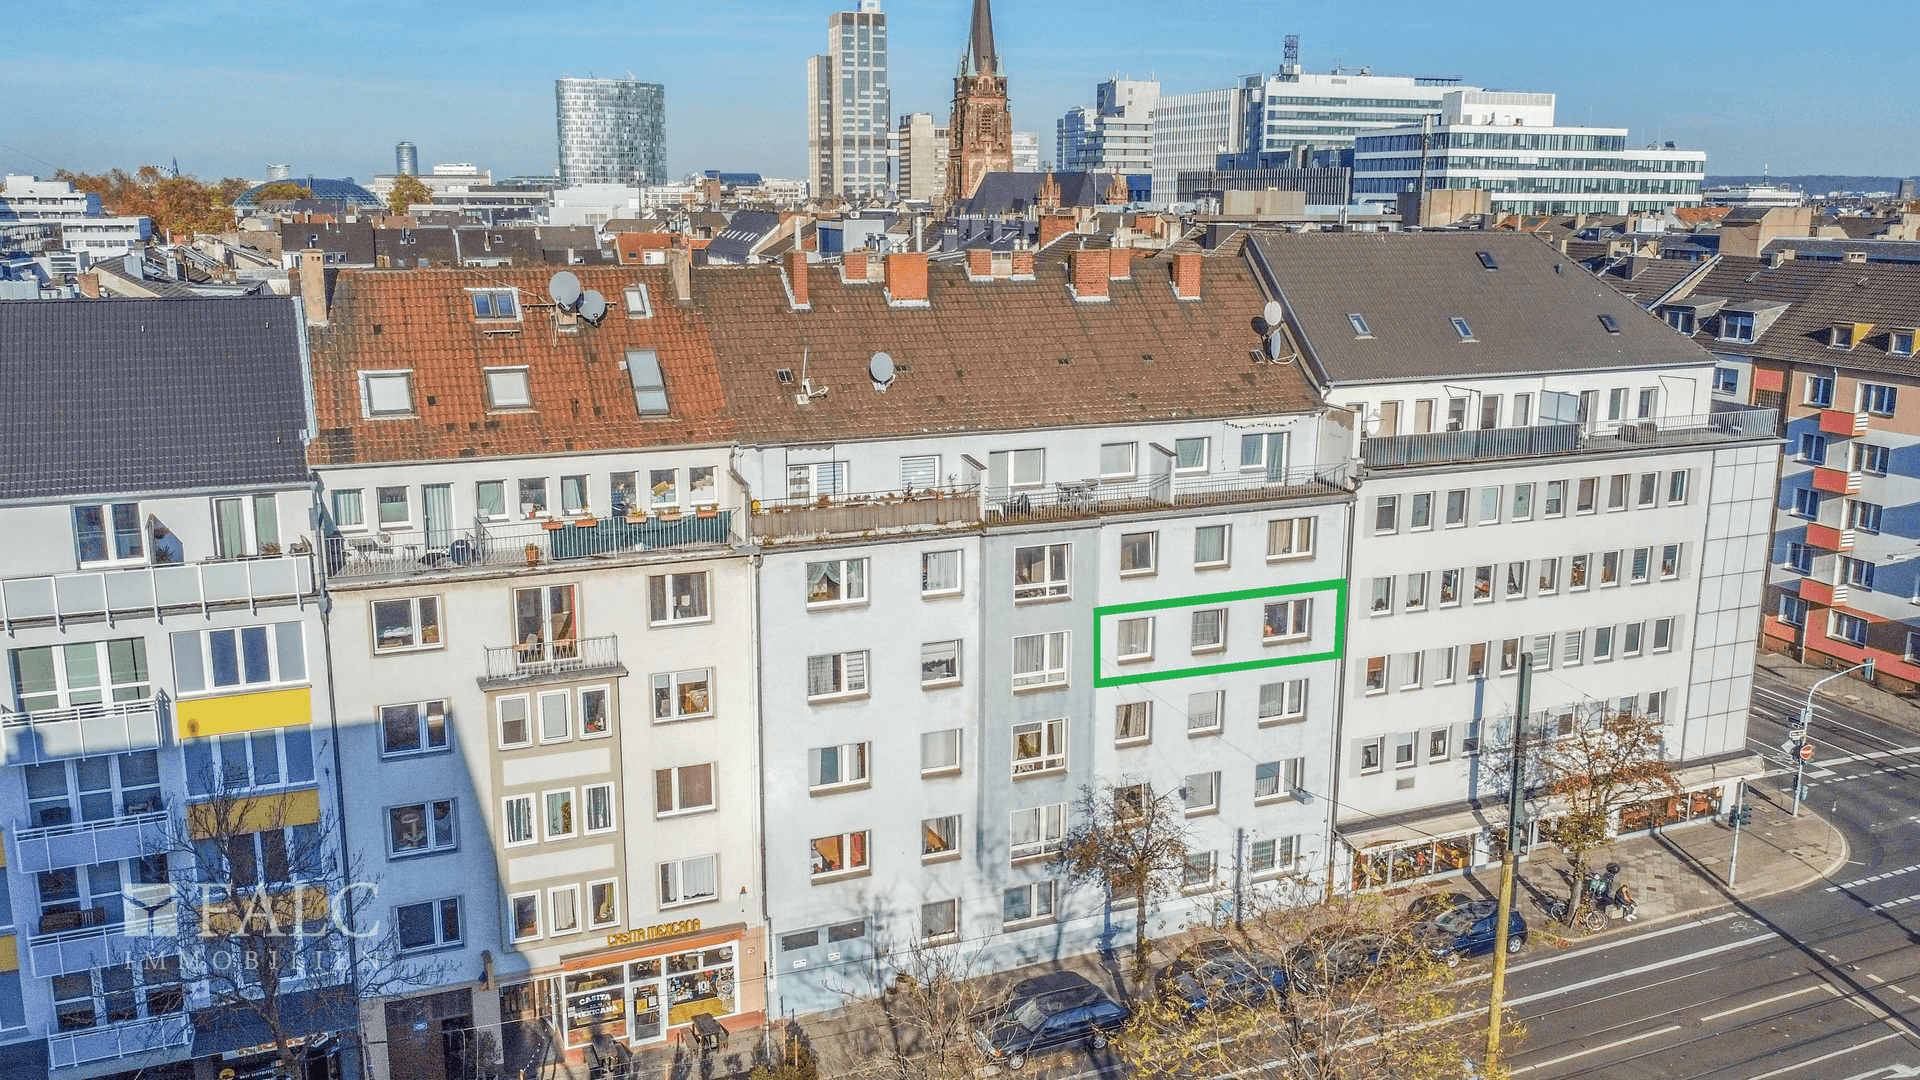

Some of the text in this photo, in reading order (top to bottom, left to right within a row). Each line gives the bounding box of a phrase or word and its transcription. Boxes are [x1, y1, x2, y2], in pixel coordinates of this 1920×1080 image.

[607, 918, 701, 947] CASITA MEXICANA
[579, 994, 611, 1005] CASITA
[574, 1005, 618, 1019] MEXICANA
